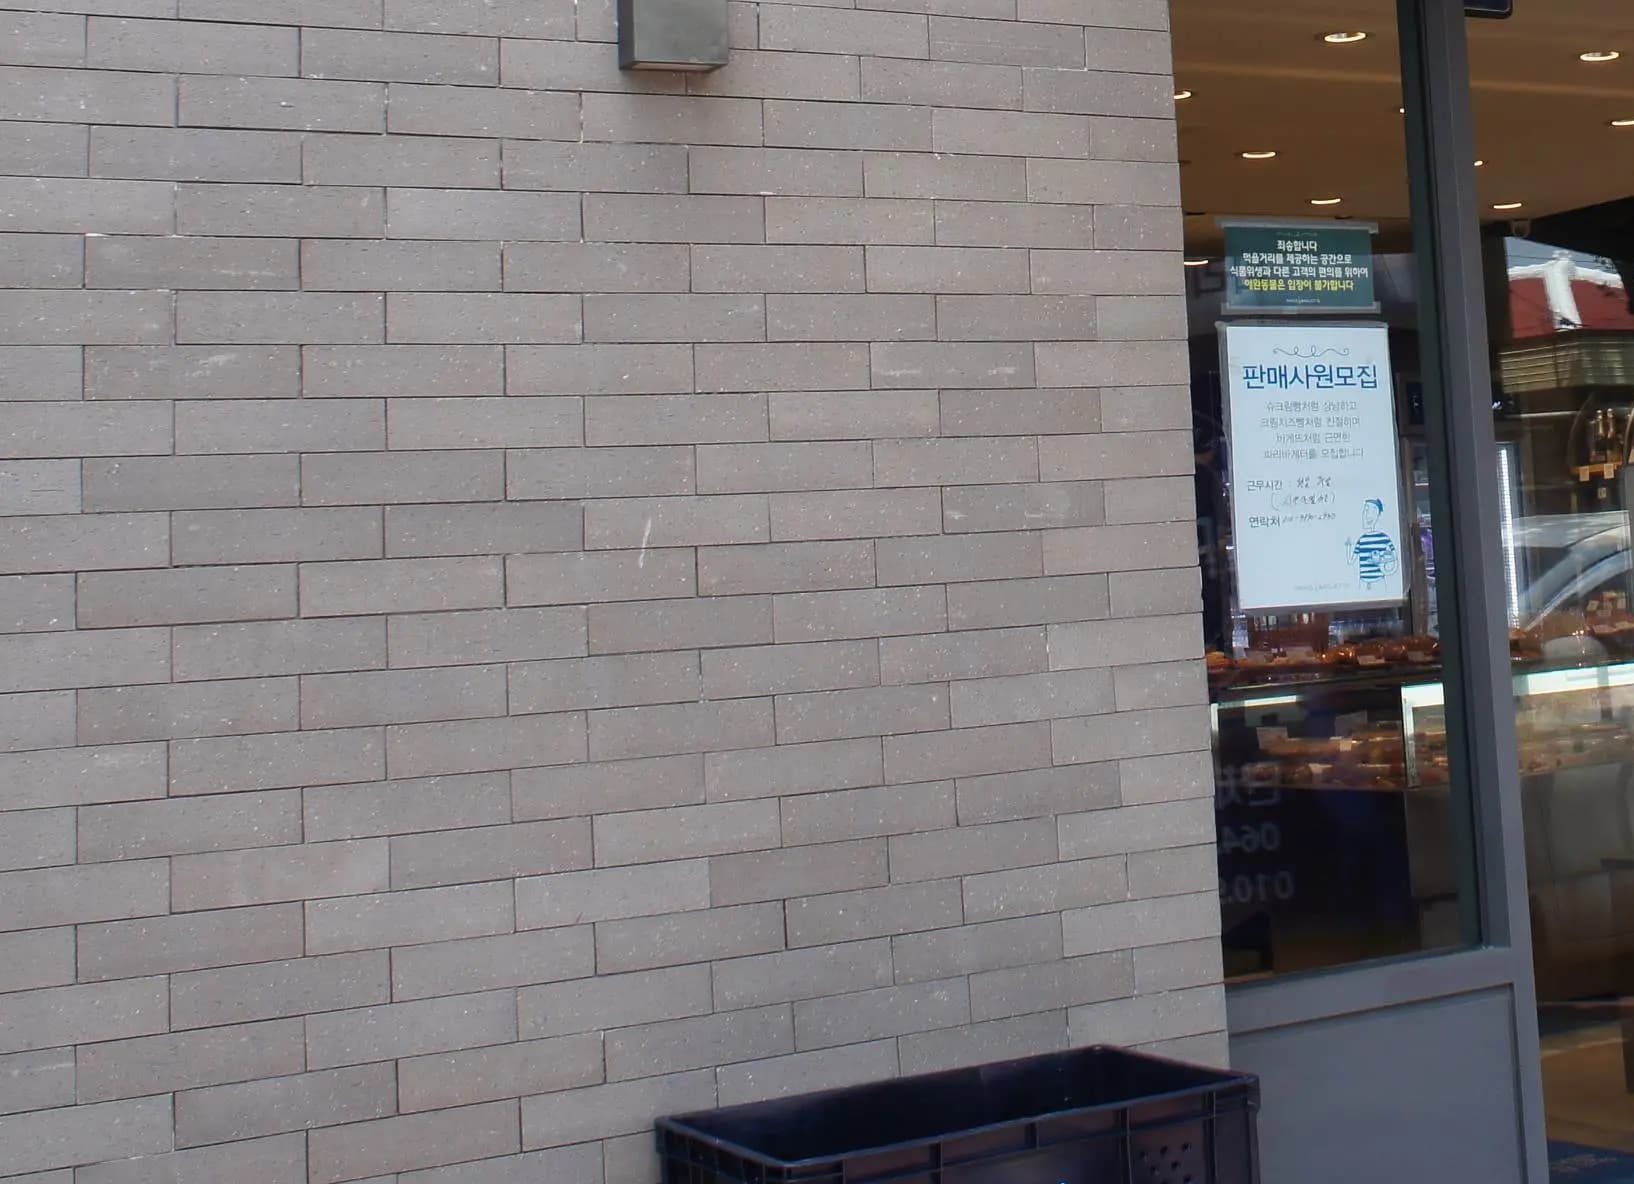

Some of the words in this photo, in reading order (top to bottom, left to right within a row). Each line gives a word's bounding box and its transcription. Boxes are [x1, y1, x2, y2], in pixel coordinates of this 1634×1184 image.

[1277, 240, 1317, 252] 죄송합니다
[1286, 254, 1318, 265] 제공하는
[1320, 254, 1352, 265] 공간으로
[1230, 266, 1271, 277] 식품위생과
[1273, 266, 1290, 277] 다른
[1293, 266, 1316, 277] 고객의
[1319, 267, 1342, 277] 편의를
[1345, 267, 1369, 278] 위하여
[1243, 364, 1378, 390] 판매사원모집
[1247, 480, 1283, 491] 근무시간
[1249, 516, 1280, 528] 연락처
